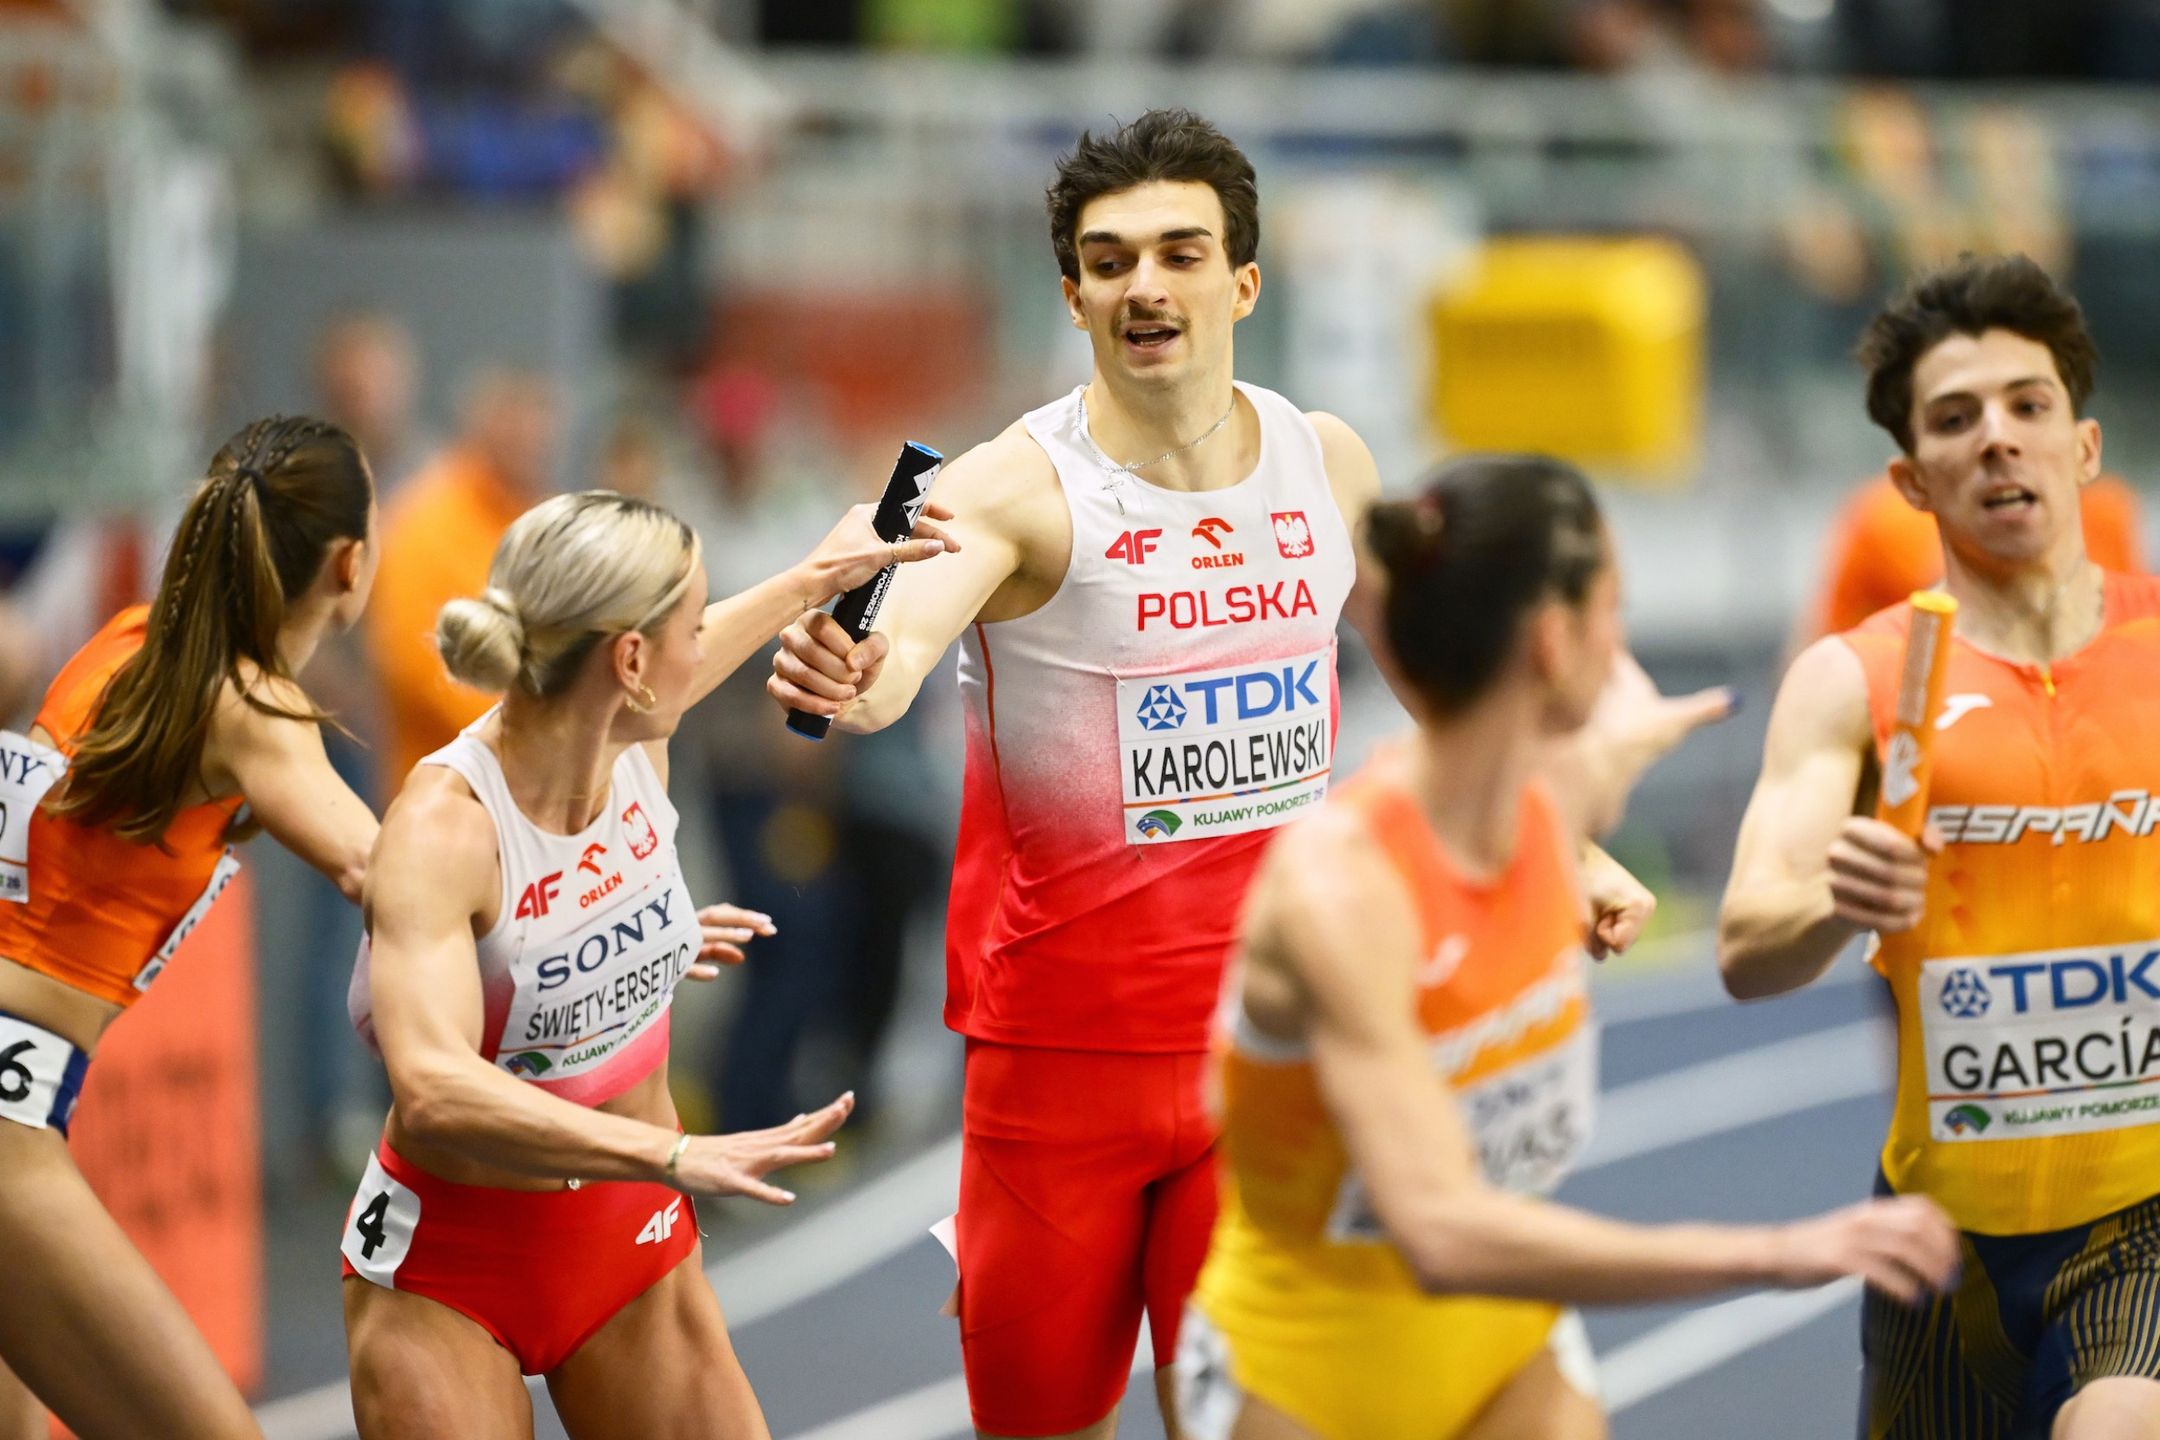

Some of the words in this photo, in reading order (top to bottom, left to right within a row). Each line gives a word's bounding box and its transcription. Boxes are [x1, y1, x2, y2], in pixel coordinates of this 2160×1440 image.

[1105, 528, 1163, 565] 4F
[1191, 552, 1244, 570] ORLEN
[1137, 579, 1318, 632] POLSKA
[1185, 659, 1320, 725] TDK
[1132, 718, 1325, 797] KAROLEWSKI
[1193, 806, 1254, 826] KUJAWY
[1256, 792, 1312, 817] POMORZE
[515, 871, 563, 920] 4F
[578, 871, 624, 909] ORLEN
[537, 889, 673, 993] SONY
[1988, 950, 2160, 1014] TDK
[0, 1040, 37, 1103] 6
[2003, 1107, 2074, 1125] KUJAWY
[2078, 1094, 2160, 1117] POMORZE
[356, 1190, 390, 1260] 4
[635, 1195, 684, 1245] 4F
